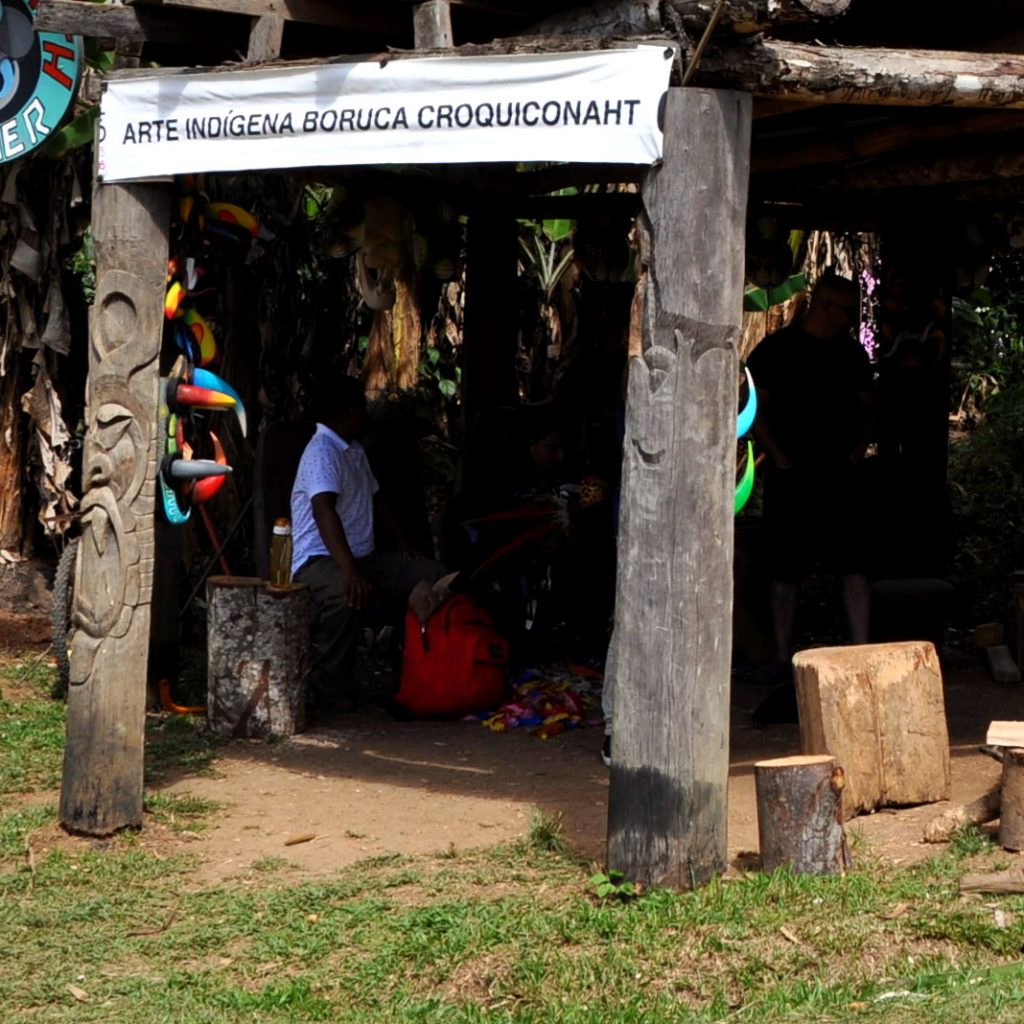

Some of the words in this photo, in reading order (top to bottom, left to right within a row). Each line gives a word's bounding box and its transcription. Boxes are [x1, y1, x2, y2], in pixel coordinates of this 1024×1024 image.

[122, 118, 180, 145] ARTE
[185, 109, 295, 140] INDÍGENA
[302, 106, 408, 133] BORUCA
[417, 99, 641, 129] CROQUICONAHT
